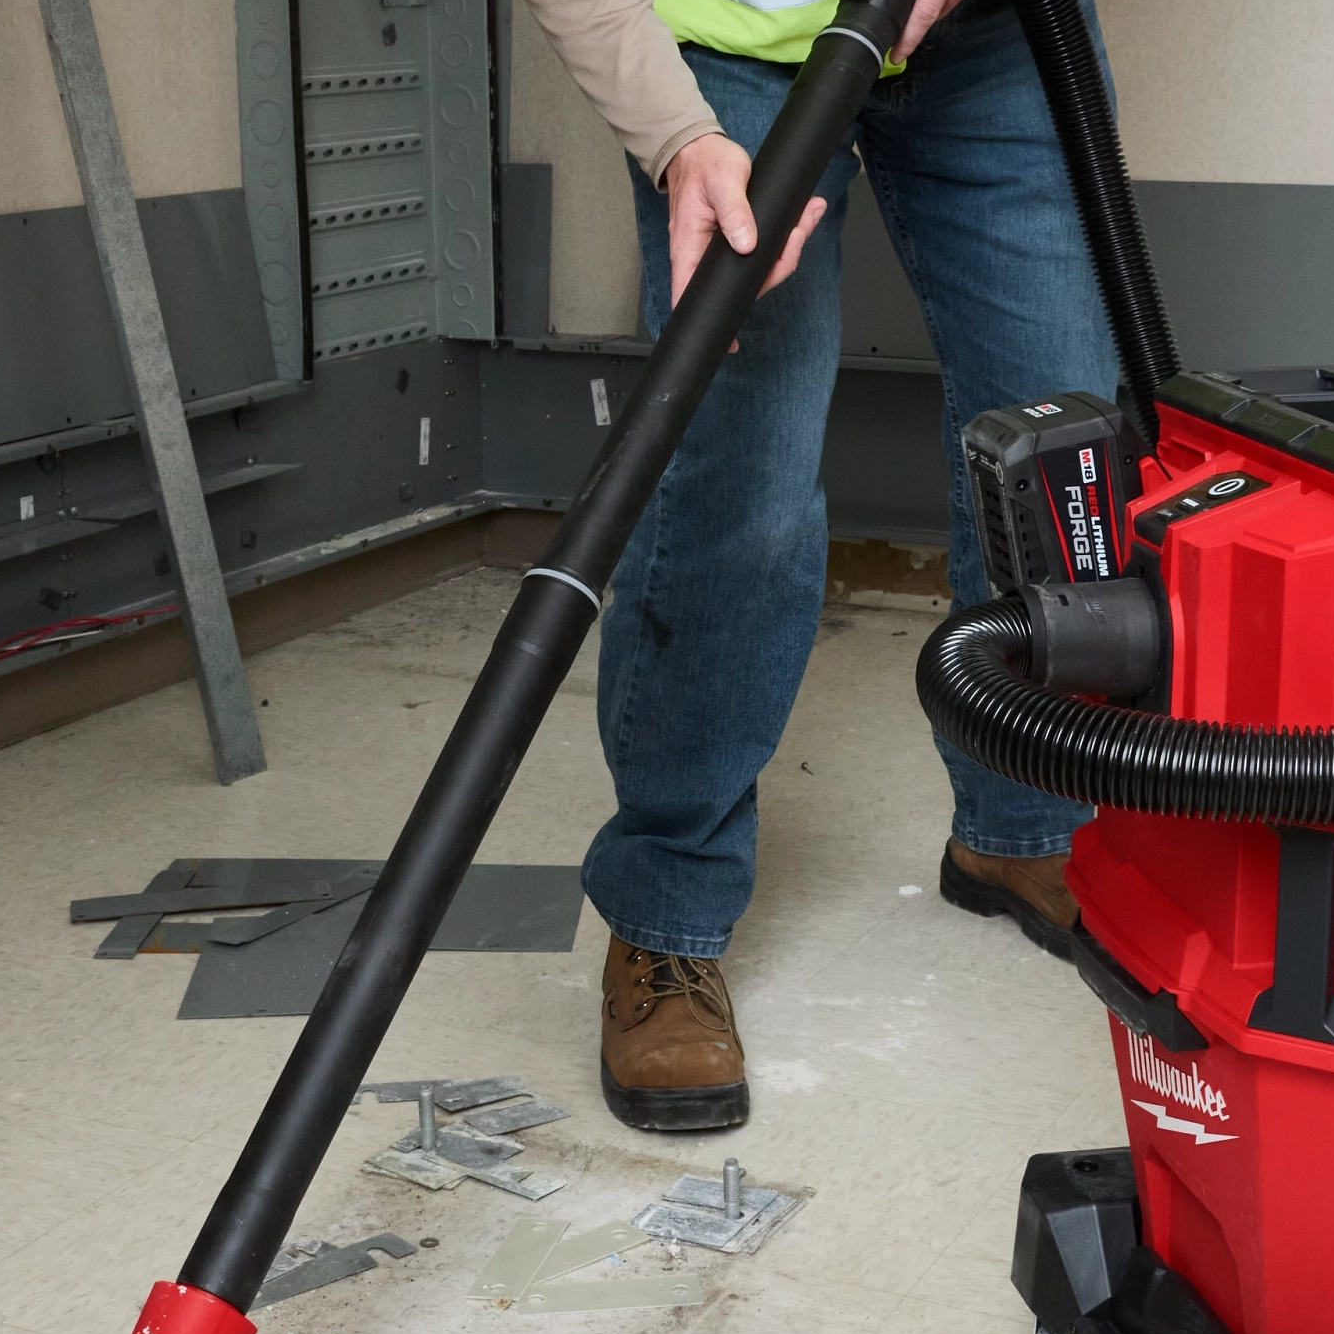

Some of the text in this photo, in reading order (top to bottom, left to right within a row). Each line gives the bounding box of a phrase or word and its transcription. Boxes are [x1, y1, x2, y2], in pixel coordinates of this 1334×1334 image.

[1081, 450, 1094, 480] M18
[1065, 485, 1093, 570] FORGE
[1120, 1021, 1230, 1122] Milwaukee
